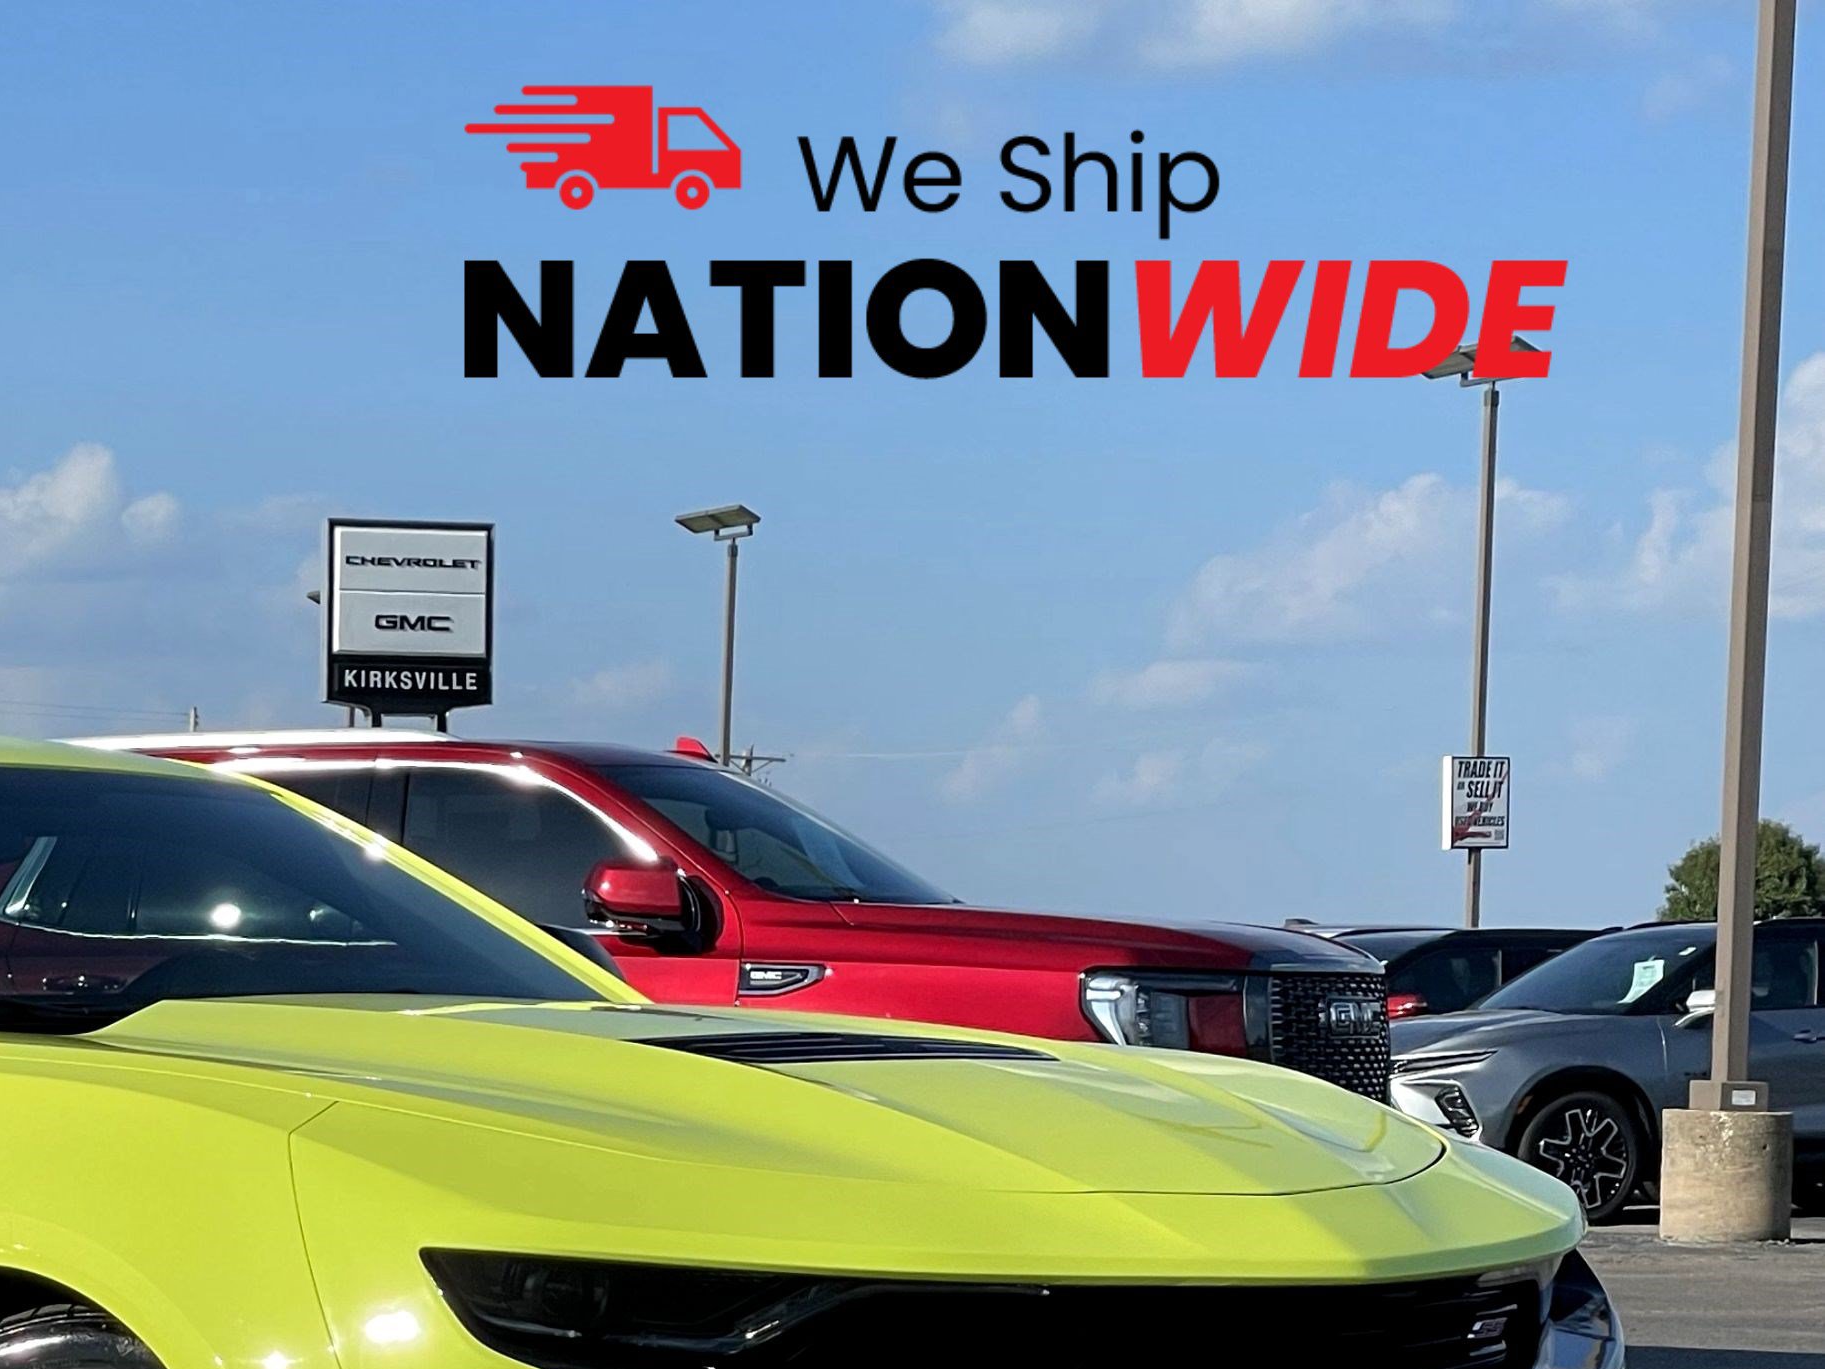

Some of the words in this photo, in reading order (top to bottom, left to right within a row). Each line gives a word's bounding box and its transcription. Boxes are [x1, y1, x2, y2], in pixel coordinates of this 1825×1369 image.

[345, 555, 481, 569] CHEVROLET
[374, 614, 454, 632] GMC
[344, 669, 477, 690] KIRKSVILLE
[1457, 761, 1492, 778] TRADE
[1493, 761, 1505, 778] IT
[1466, 781, 1490, 798] SELL
[749, 971, 782, 980] GMC
